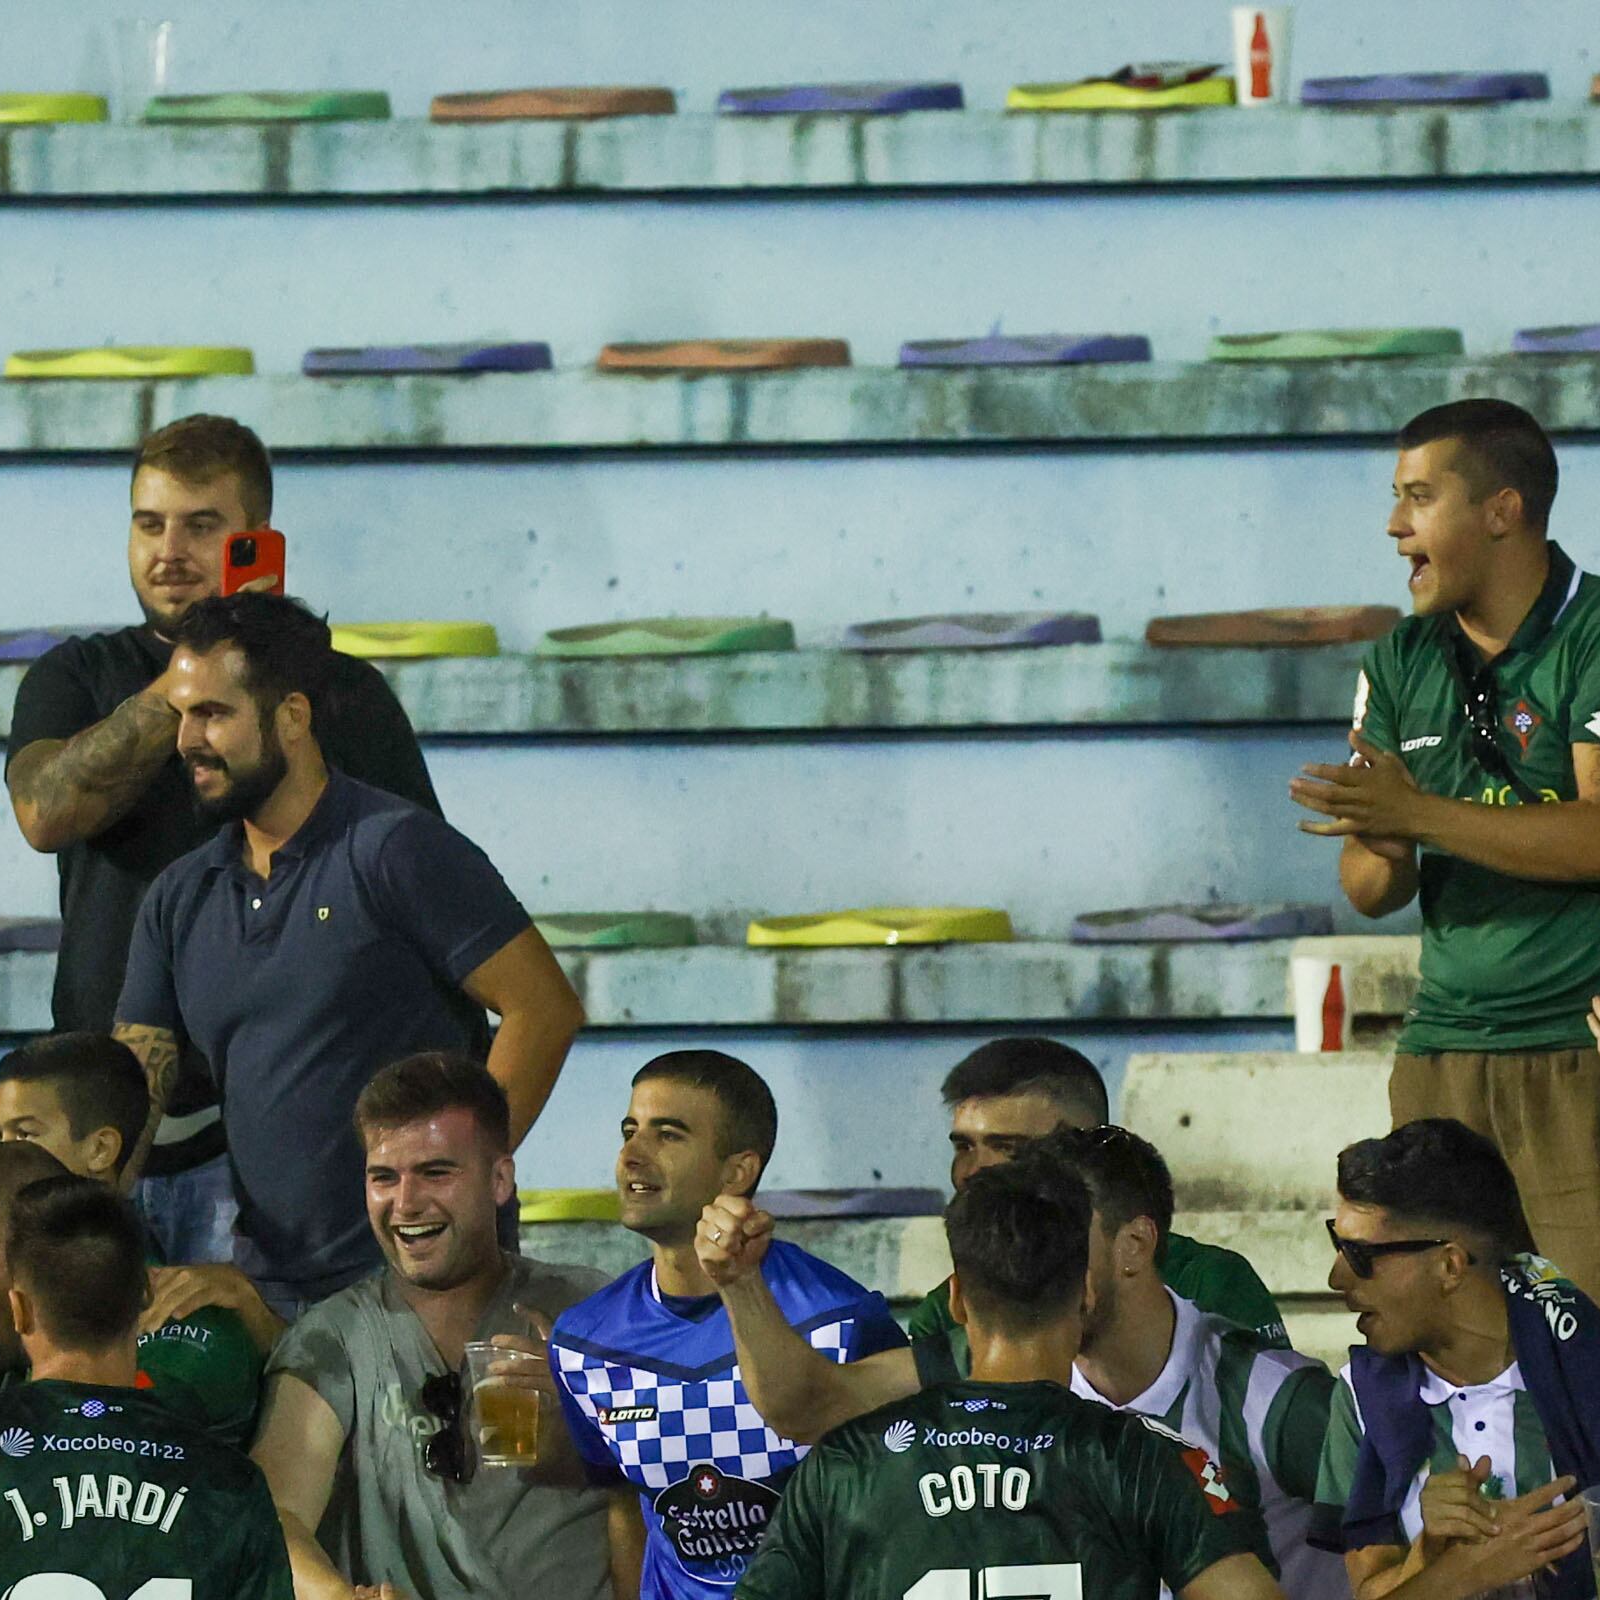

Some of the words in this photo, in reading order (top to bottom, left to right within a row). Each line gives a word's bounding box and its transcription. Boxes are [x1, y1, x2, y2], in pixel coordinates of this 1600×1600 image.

[609, 1407, 654, 1421] LOTTO
[42, 1433, 136, 1454] Xacobeo
[923, 1426, 1010, 1450] Xacobeo
[918, 1463, 1031, 1518] COTO
[3, 1487, 48, 1542] J.
[668, 1501, 766, 1530] Estrella
